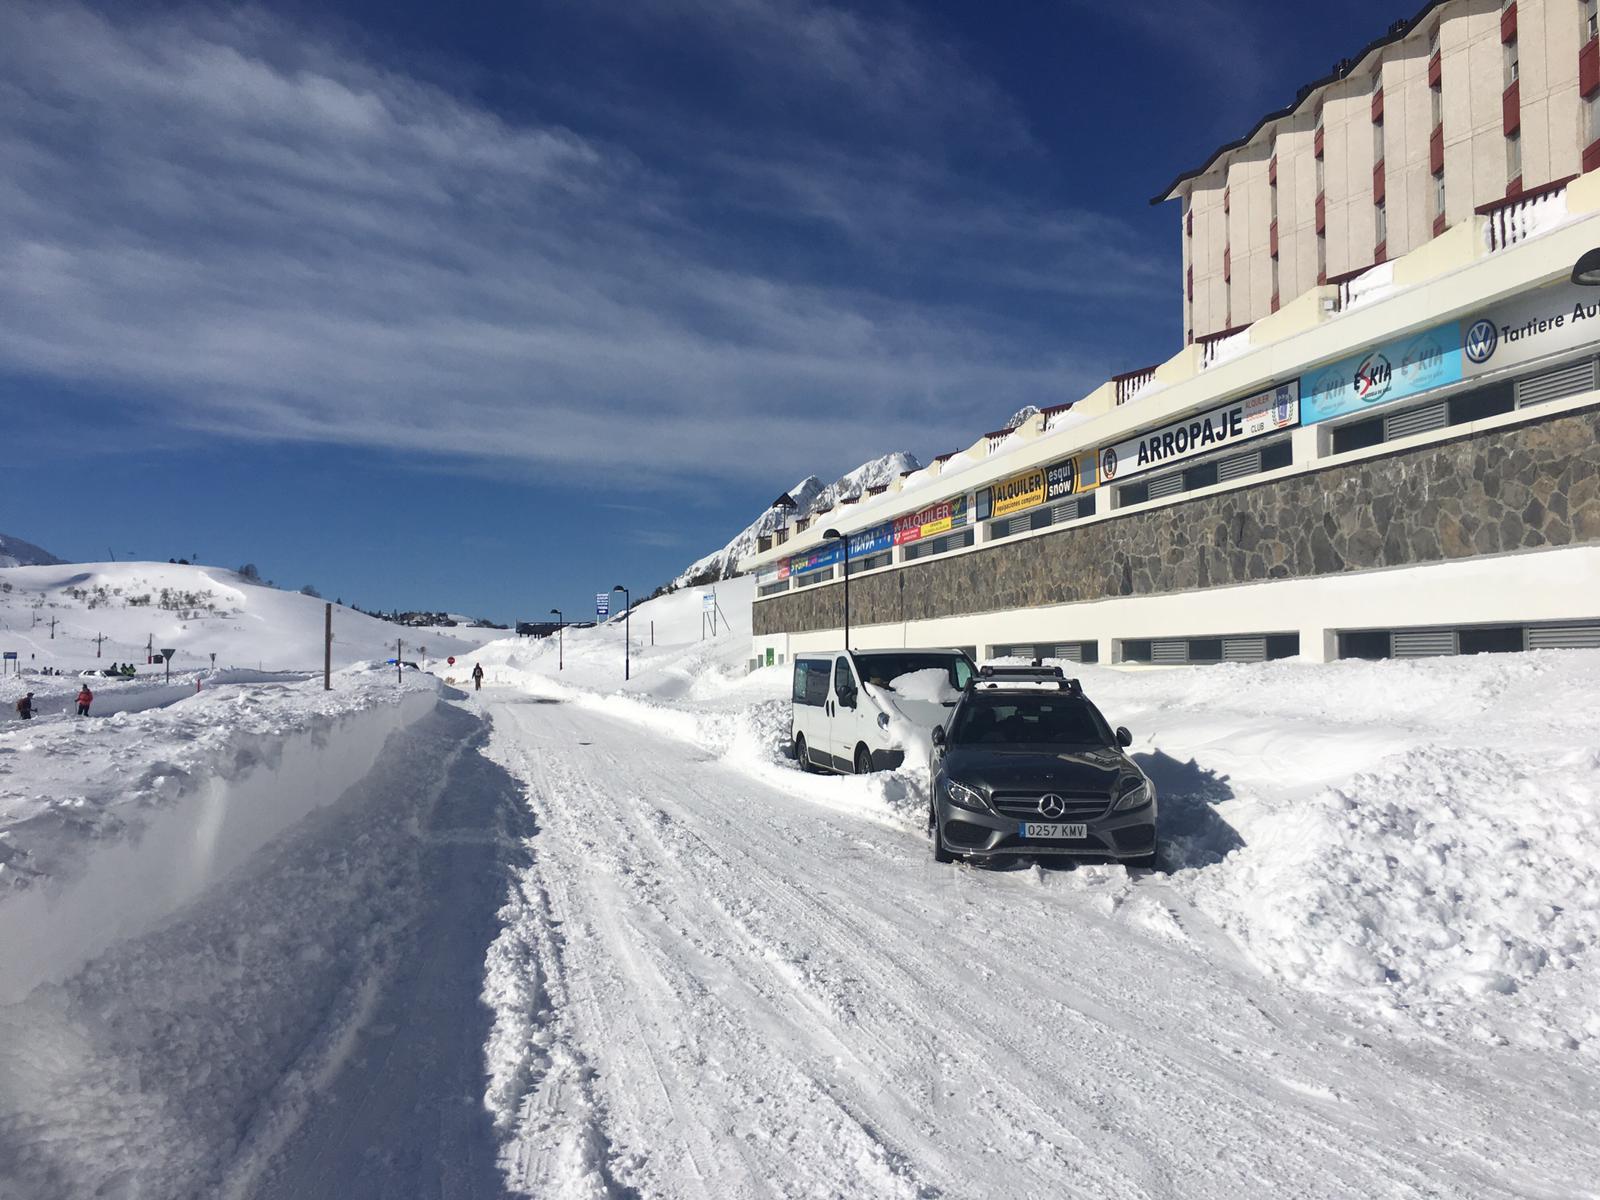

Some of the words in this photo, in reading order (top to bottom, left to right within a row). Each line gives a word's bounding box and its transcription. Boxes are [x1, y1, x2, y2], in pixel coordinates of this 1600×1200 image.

[1501, 315, 1564, 344] Tartiere
[1571, 302, 1600, 323] Au
[1353, 361, 1392, 397] ESKIA
[1137, 407, 1243, 466] ARROPAJE
[1250, 422, 1265, 433] CLUB
[1048, 462, 1070, 482] esqui
[997, 474, 1041, 503] ALQUILER
[1048, 480, 1071, 497] snow
[902, 505, 949, 529] ALQUILER
[1027, 825, 1057, 836] 0257
[1061, 825, 1084, 836] KMV
